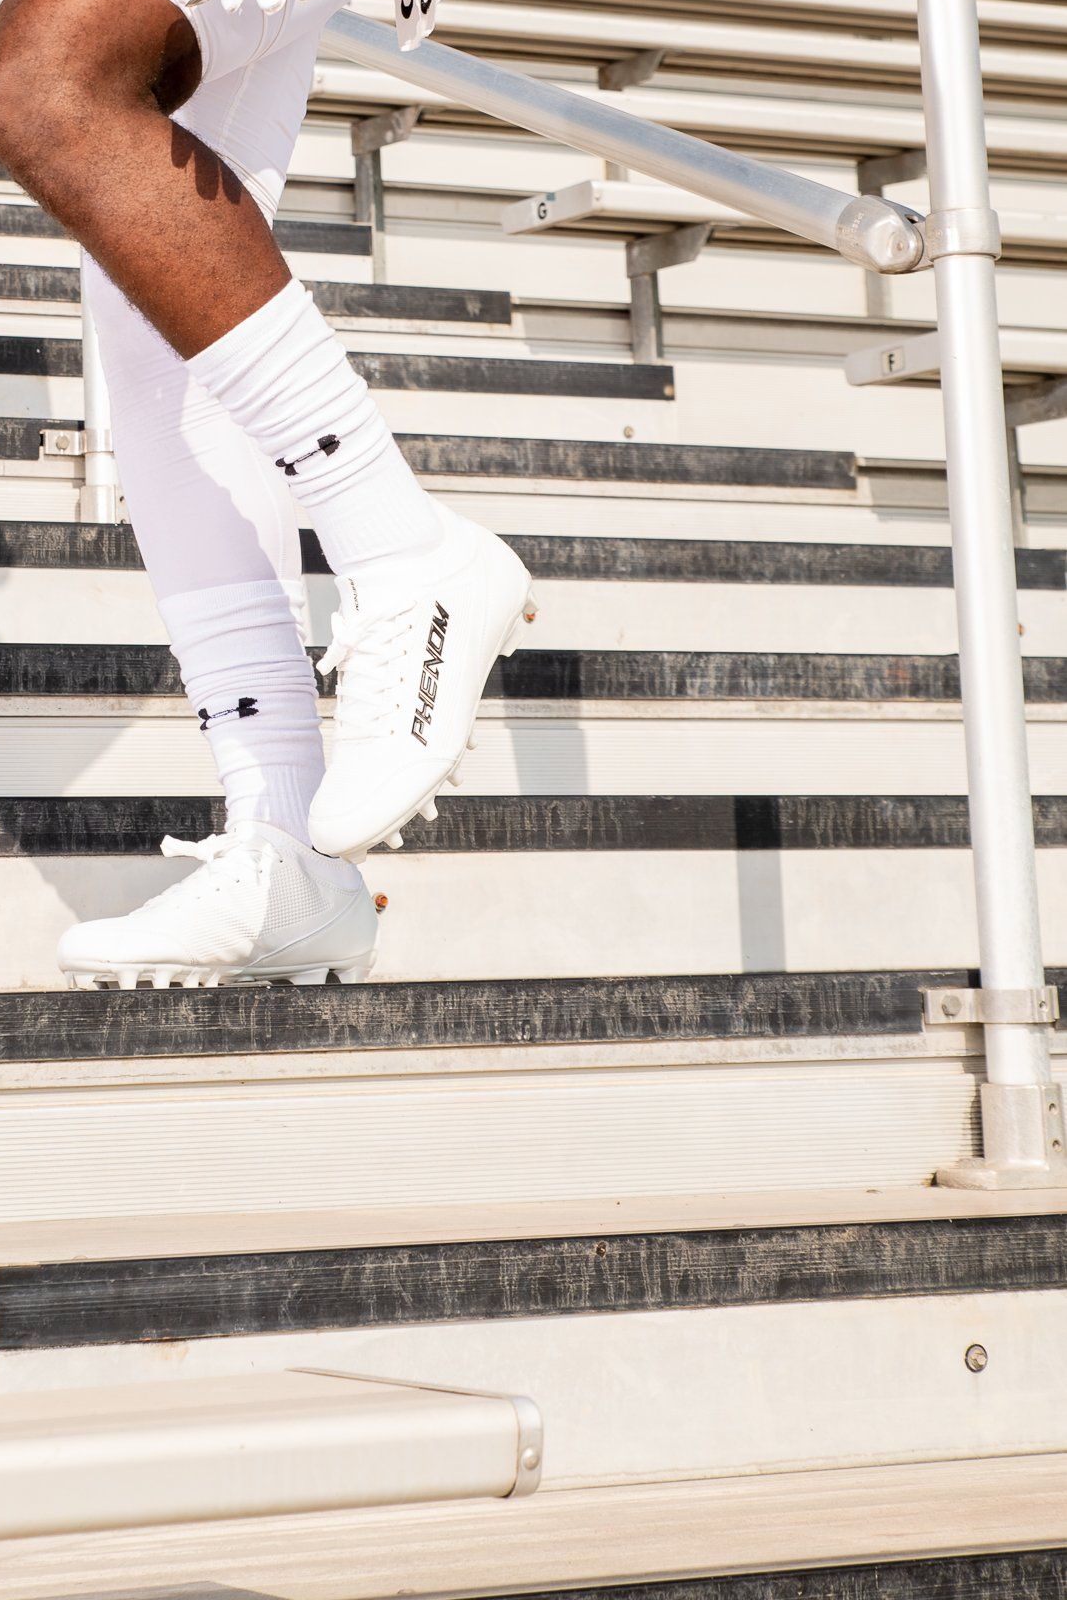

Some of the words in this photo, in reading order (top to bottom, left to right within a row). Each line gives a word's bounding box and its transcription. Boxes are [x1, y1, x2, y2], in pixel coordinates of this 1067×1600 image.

[537, 202, 548, 220] G
[888, 353, 895, 373] F
[411, 600, 450, 747] PHENOM
